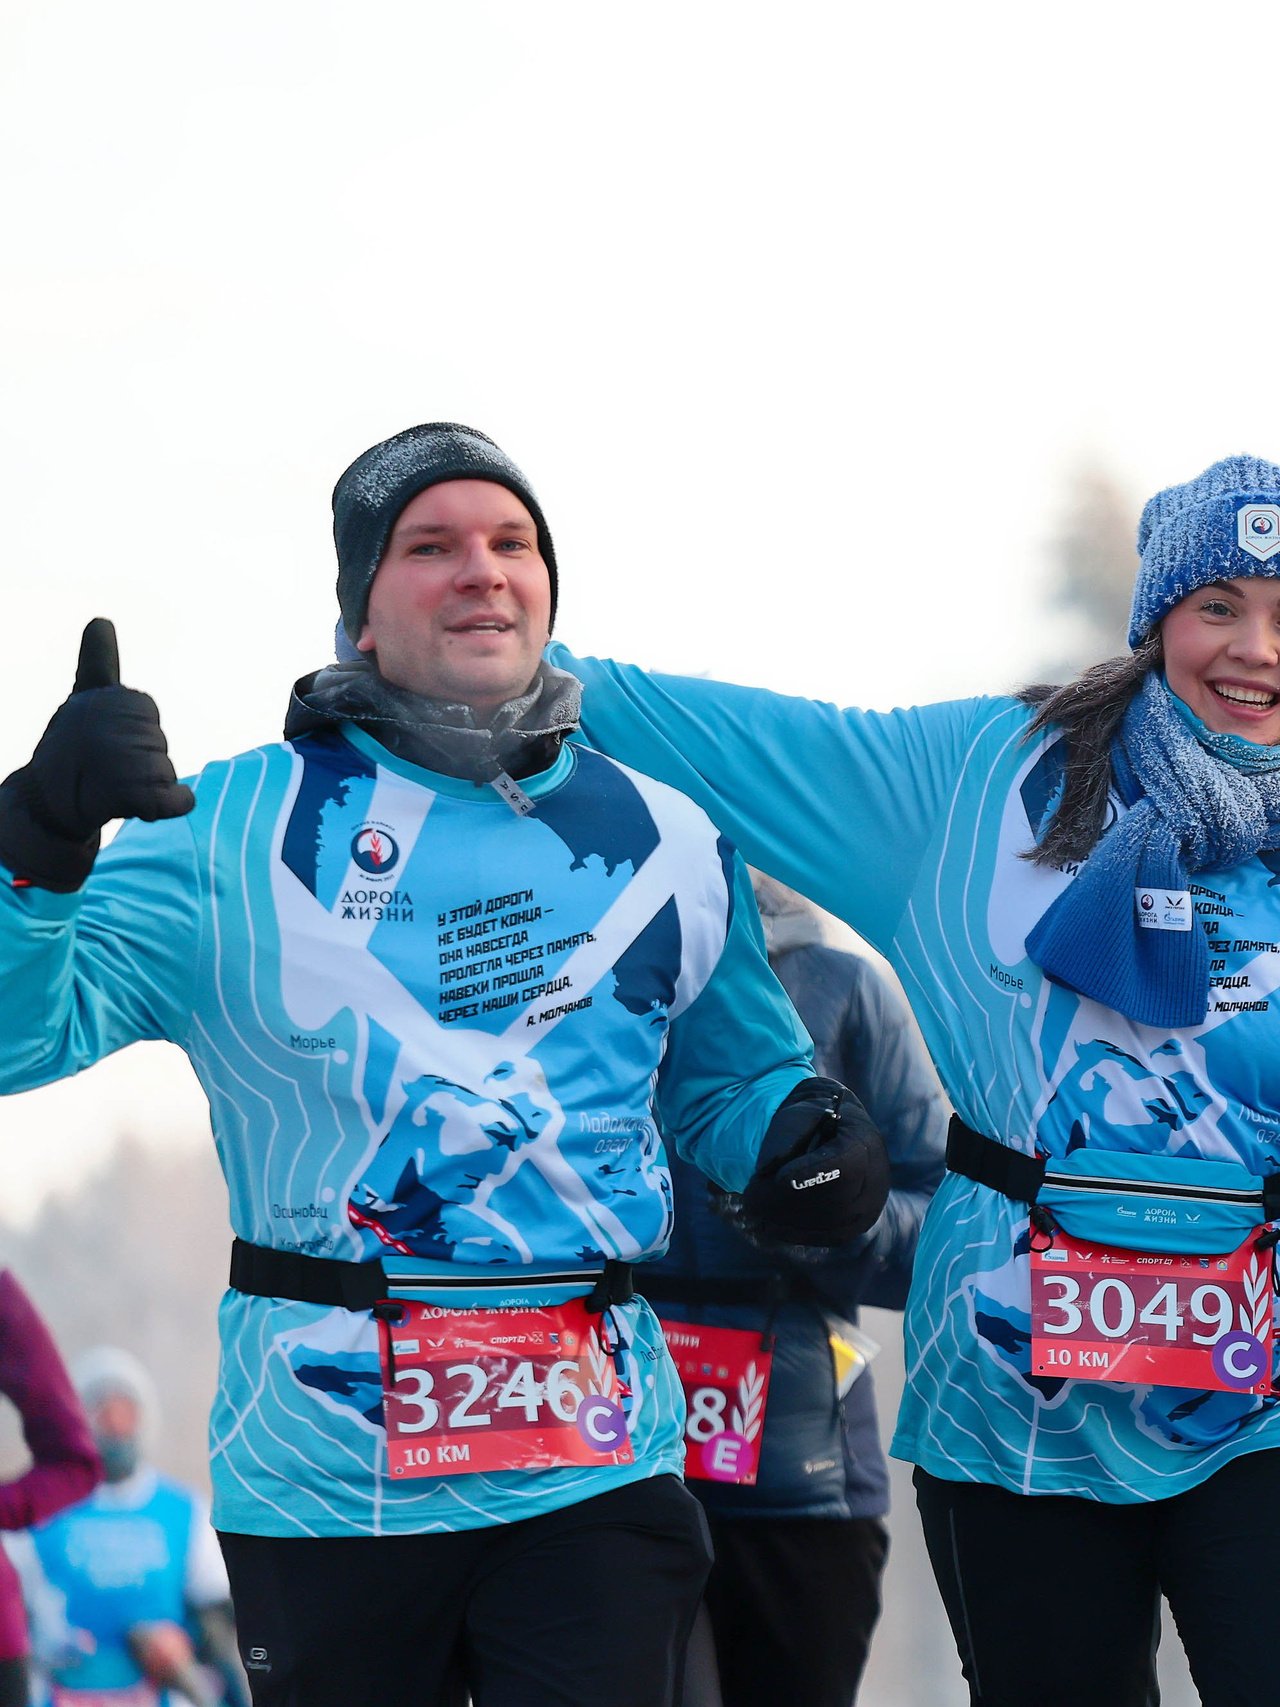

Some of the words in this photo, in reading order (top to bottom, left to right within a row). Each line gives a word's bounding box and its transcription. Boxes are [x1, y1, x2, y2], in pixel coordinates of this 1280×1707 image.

[341, 889, 413, 906] ДОРОГА
[341, 906, 414, 922] ЖИЗНИ
[438, 912, 447, 927] У
[449, 899, 482, 924] ЭТОЙ
[485, 888, 534, 916] ДОРОГИ
[1194, 902, 1234, 918] КОНЦА
[438, 930, 454, 947] НЕ
[457, 917, 498, 942] БУДЕТ
[501, 906, 542, 930] КОНЦА
[439, 948, 464, 966] ОНА
[466, 930, 529, 958] НАВСЕГДА
[1208, 940, 1232, 953] РЕЗ
[1233, 940, 1280, 954] ПАМЯТЬ,
[440, 957, 503, 986] ПРОЛЕГЛА
[505, 945, 544, 966] ЧЕРЕЗ
[547, 930, 597, 956] ПАМЯТЬ,
[439, 980, 490, 1006] НАВЕКИ
[493, 964, 545, 991] ПРОШЛА
[990, 963, 1024, 990] Морье
[1209, 975, 1252, 990] ЕРДЦА.
[438, 1003, 480, 1024] ЧЕРЕЗ
[482, 991, 519, 1014] НАШИ
[522, 976, 573, 1003] СЕРДЦА.
[1214, 1001, 1270, 1013] МОЛЧАНОВ
[526, 1015, 537, 1027] А.
[539, 996, 593, 1023] МОЛЧАНОВ
[290, 1034, 336, 1051] Морье
[1143, 1215, 1177, 1224] ЖИЗНИ
[1144, 1208, 1177, 1217] ДОРОГА
[1042, 1275, 1235, 1347] 3049
[1046, 1349, 1072, 1366] 10
[393, 1360, 585, 1434] 3246
[404, 1449, 431, 1467] 10
